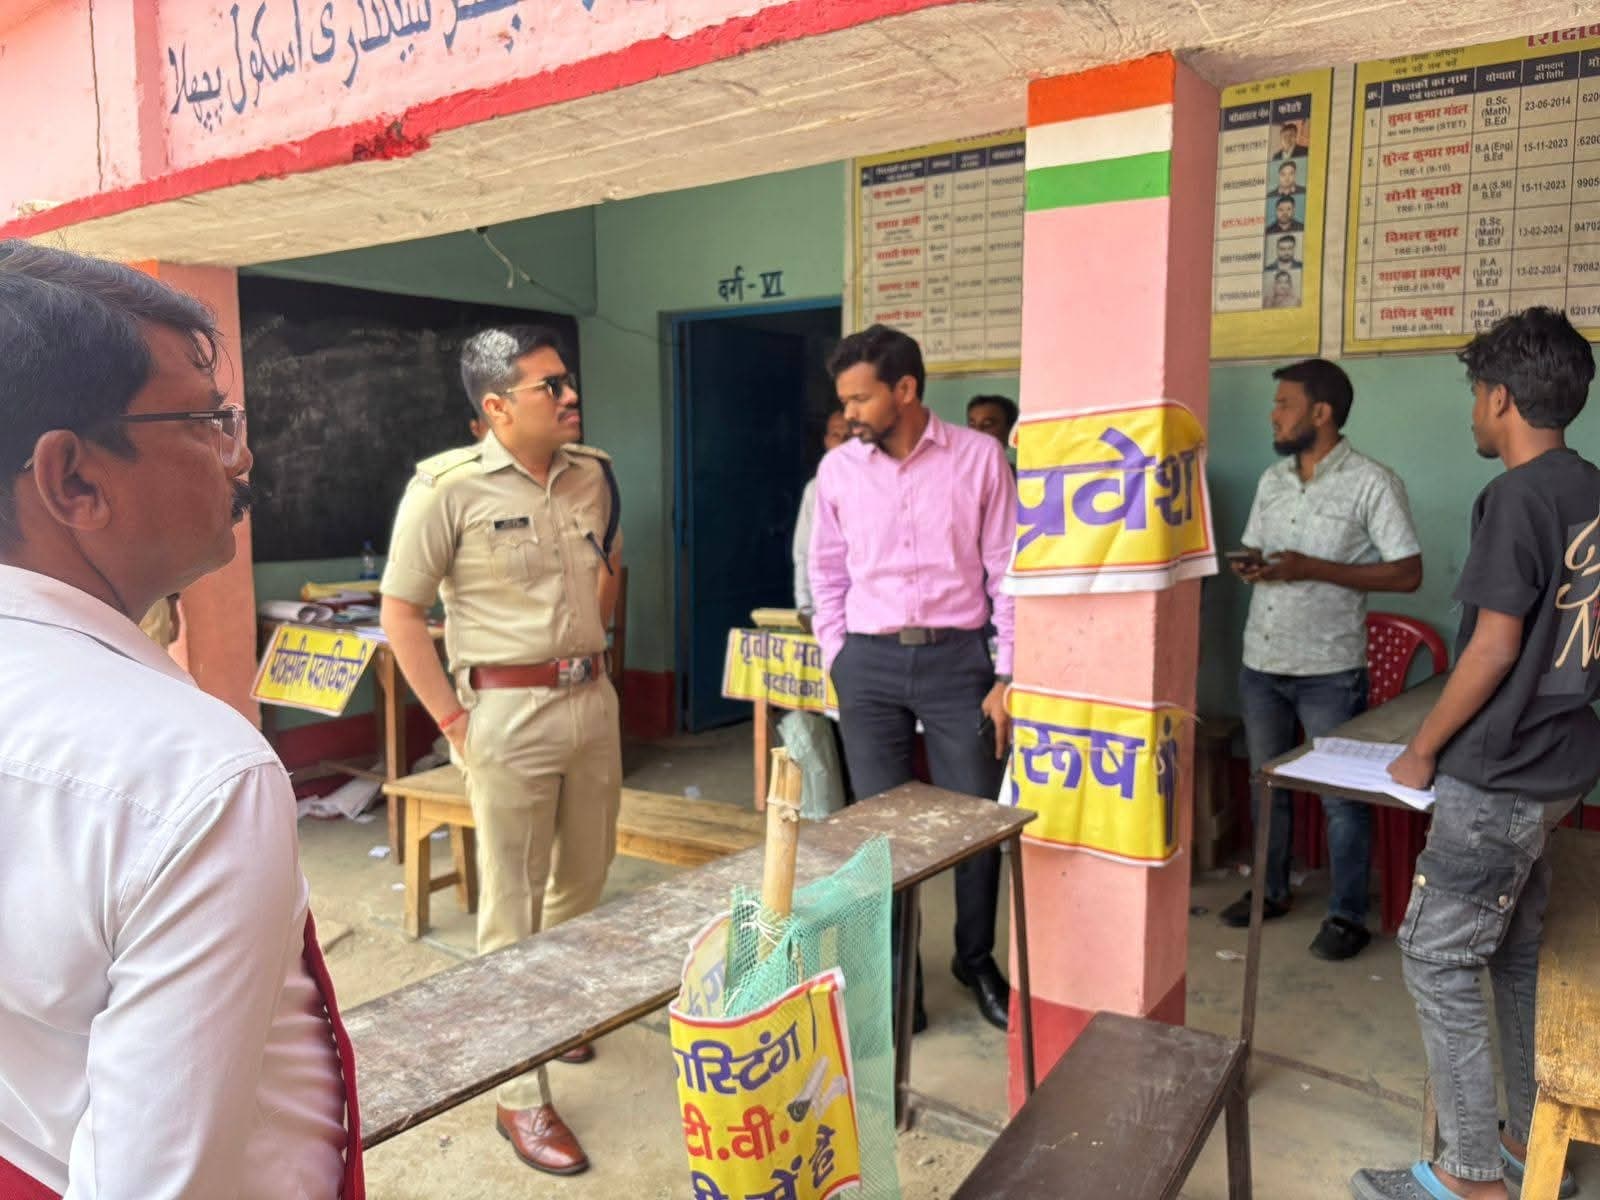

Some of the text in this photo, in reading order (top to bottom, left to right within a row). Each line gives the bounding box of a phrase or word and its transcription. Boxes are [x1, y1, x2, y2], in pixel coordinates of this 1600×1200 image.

[1524, 96, 1571, 111] 23-06-2014
[1414, 108, 1442, 123] कुमार
[1480, 105, 1512, 119] (Math)
[1523, 138, 1569, 153] 15-11-2023
[1412, 147, 1443, 163] कुमार
[1420, 181, 1463, 202] कुमारी
[1520, 179, 1567, 193] 15-11-2023
[1424, 226, 1460, 243] कुमार
[1420, 304, 1456, 321] कुमार
[793, 639, 823, 669] मत
